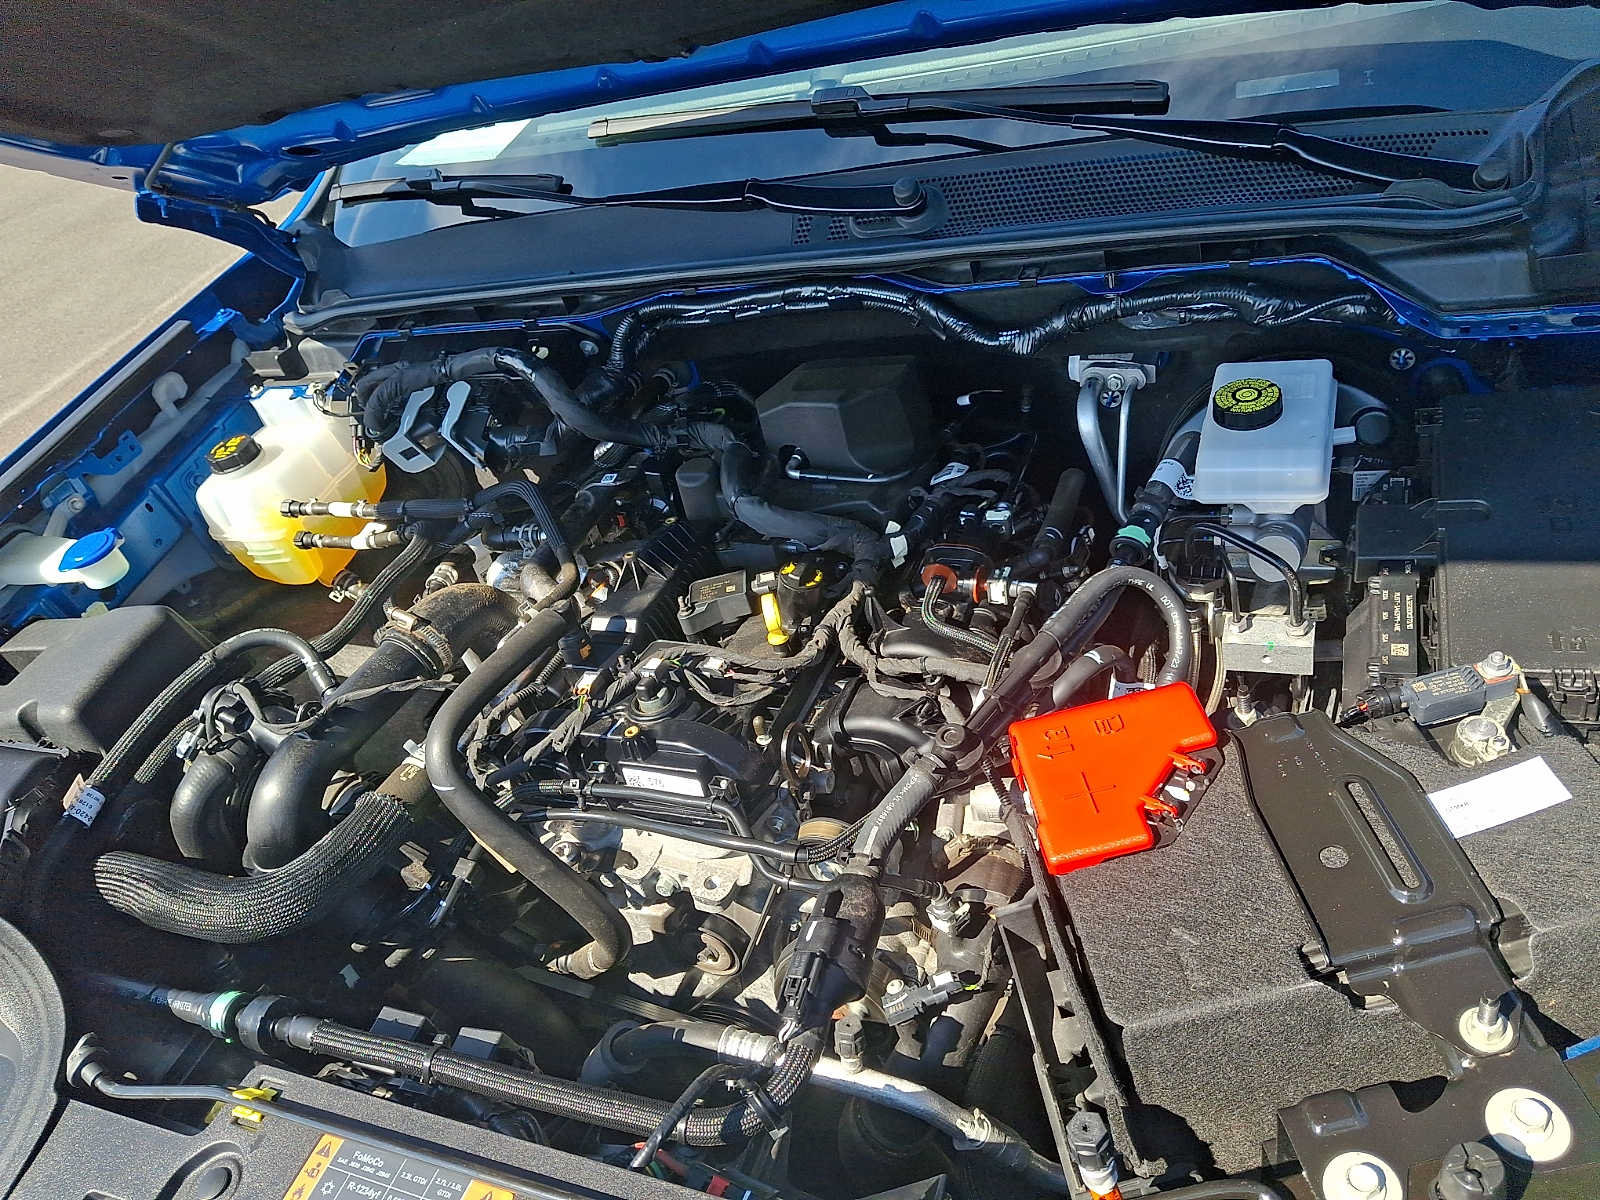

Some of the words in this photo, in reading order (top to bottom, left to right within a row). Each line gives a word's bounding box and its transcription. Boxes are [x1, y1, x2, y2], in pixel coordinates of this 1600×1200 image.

[1160, 594, 1174, 610] DOT
[352, 1150, 384, 1168] FoMoCo
[346, 1180, 382, 1200] R-1234yf
